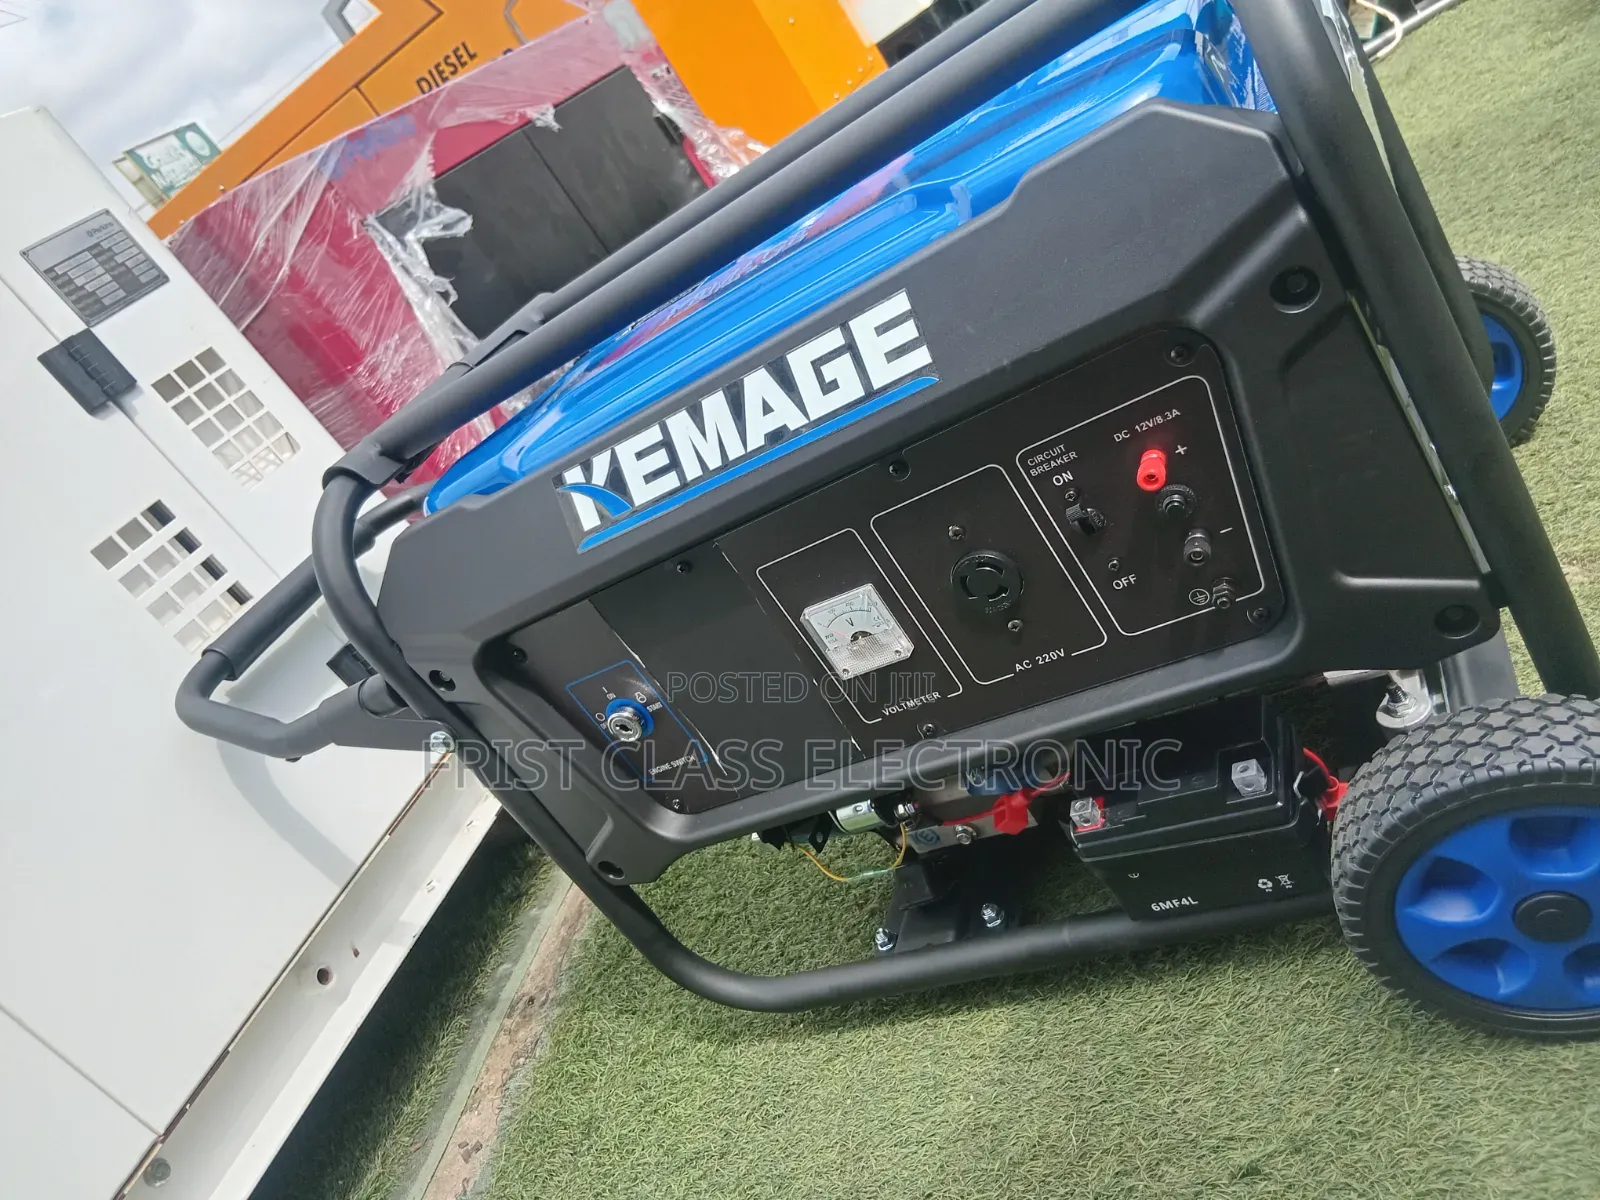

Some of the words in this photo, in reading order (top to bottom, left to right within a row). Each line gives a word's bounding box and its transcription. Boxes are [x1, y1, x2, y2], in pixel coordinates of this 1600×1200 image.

[416, 40, 478, 95] DIESEL
[558, 287, 934, 533] KEMAGE
[1113, 429, 1130, 442] DC
[1135, 408, 1181, 432] 12V/8.3A
[1027, 444, 1066, 466] CIRCUIT
[1029, 451, 1079, 477] BREAKER
[1052, 470, 1074, 486] ON
[1112, 573, 1138, 591] OFF
[1015, 659, 1032, 672] AC
[1035, 647, 1065, 665] 220V
[881, 691, 942, 716] VOLTMETER
[670, 754, 696, 768] SWITCH
[1150, 896, 1199, 912] 6MF4L
